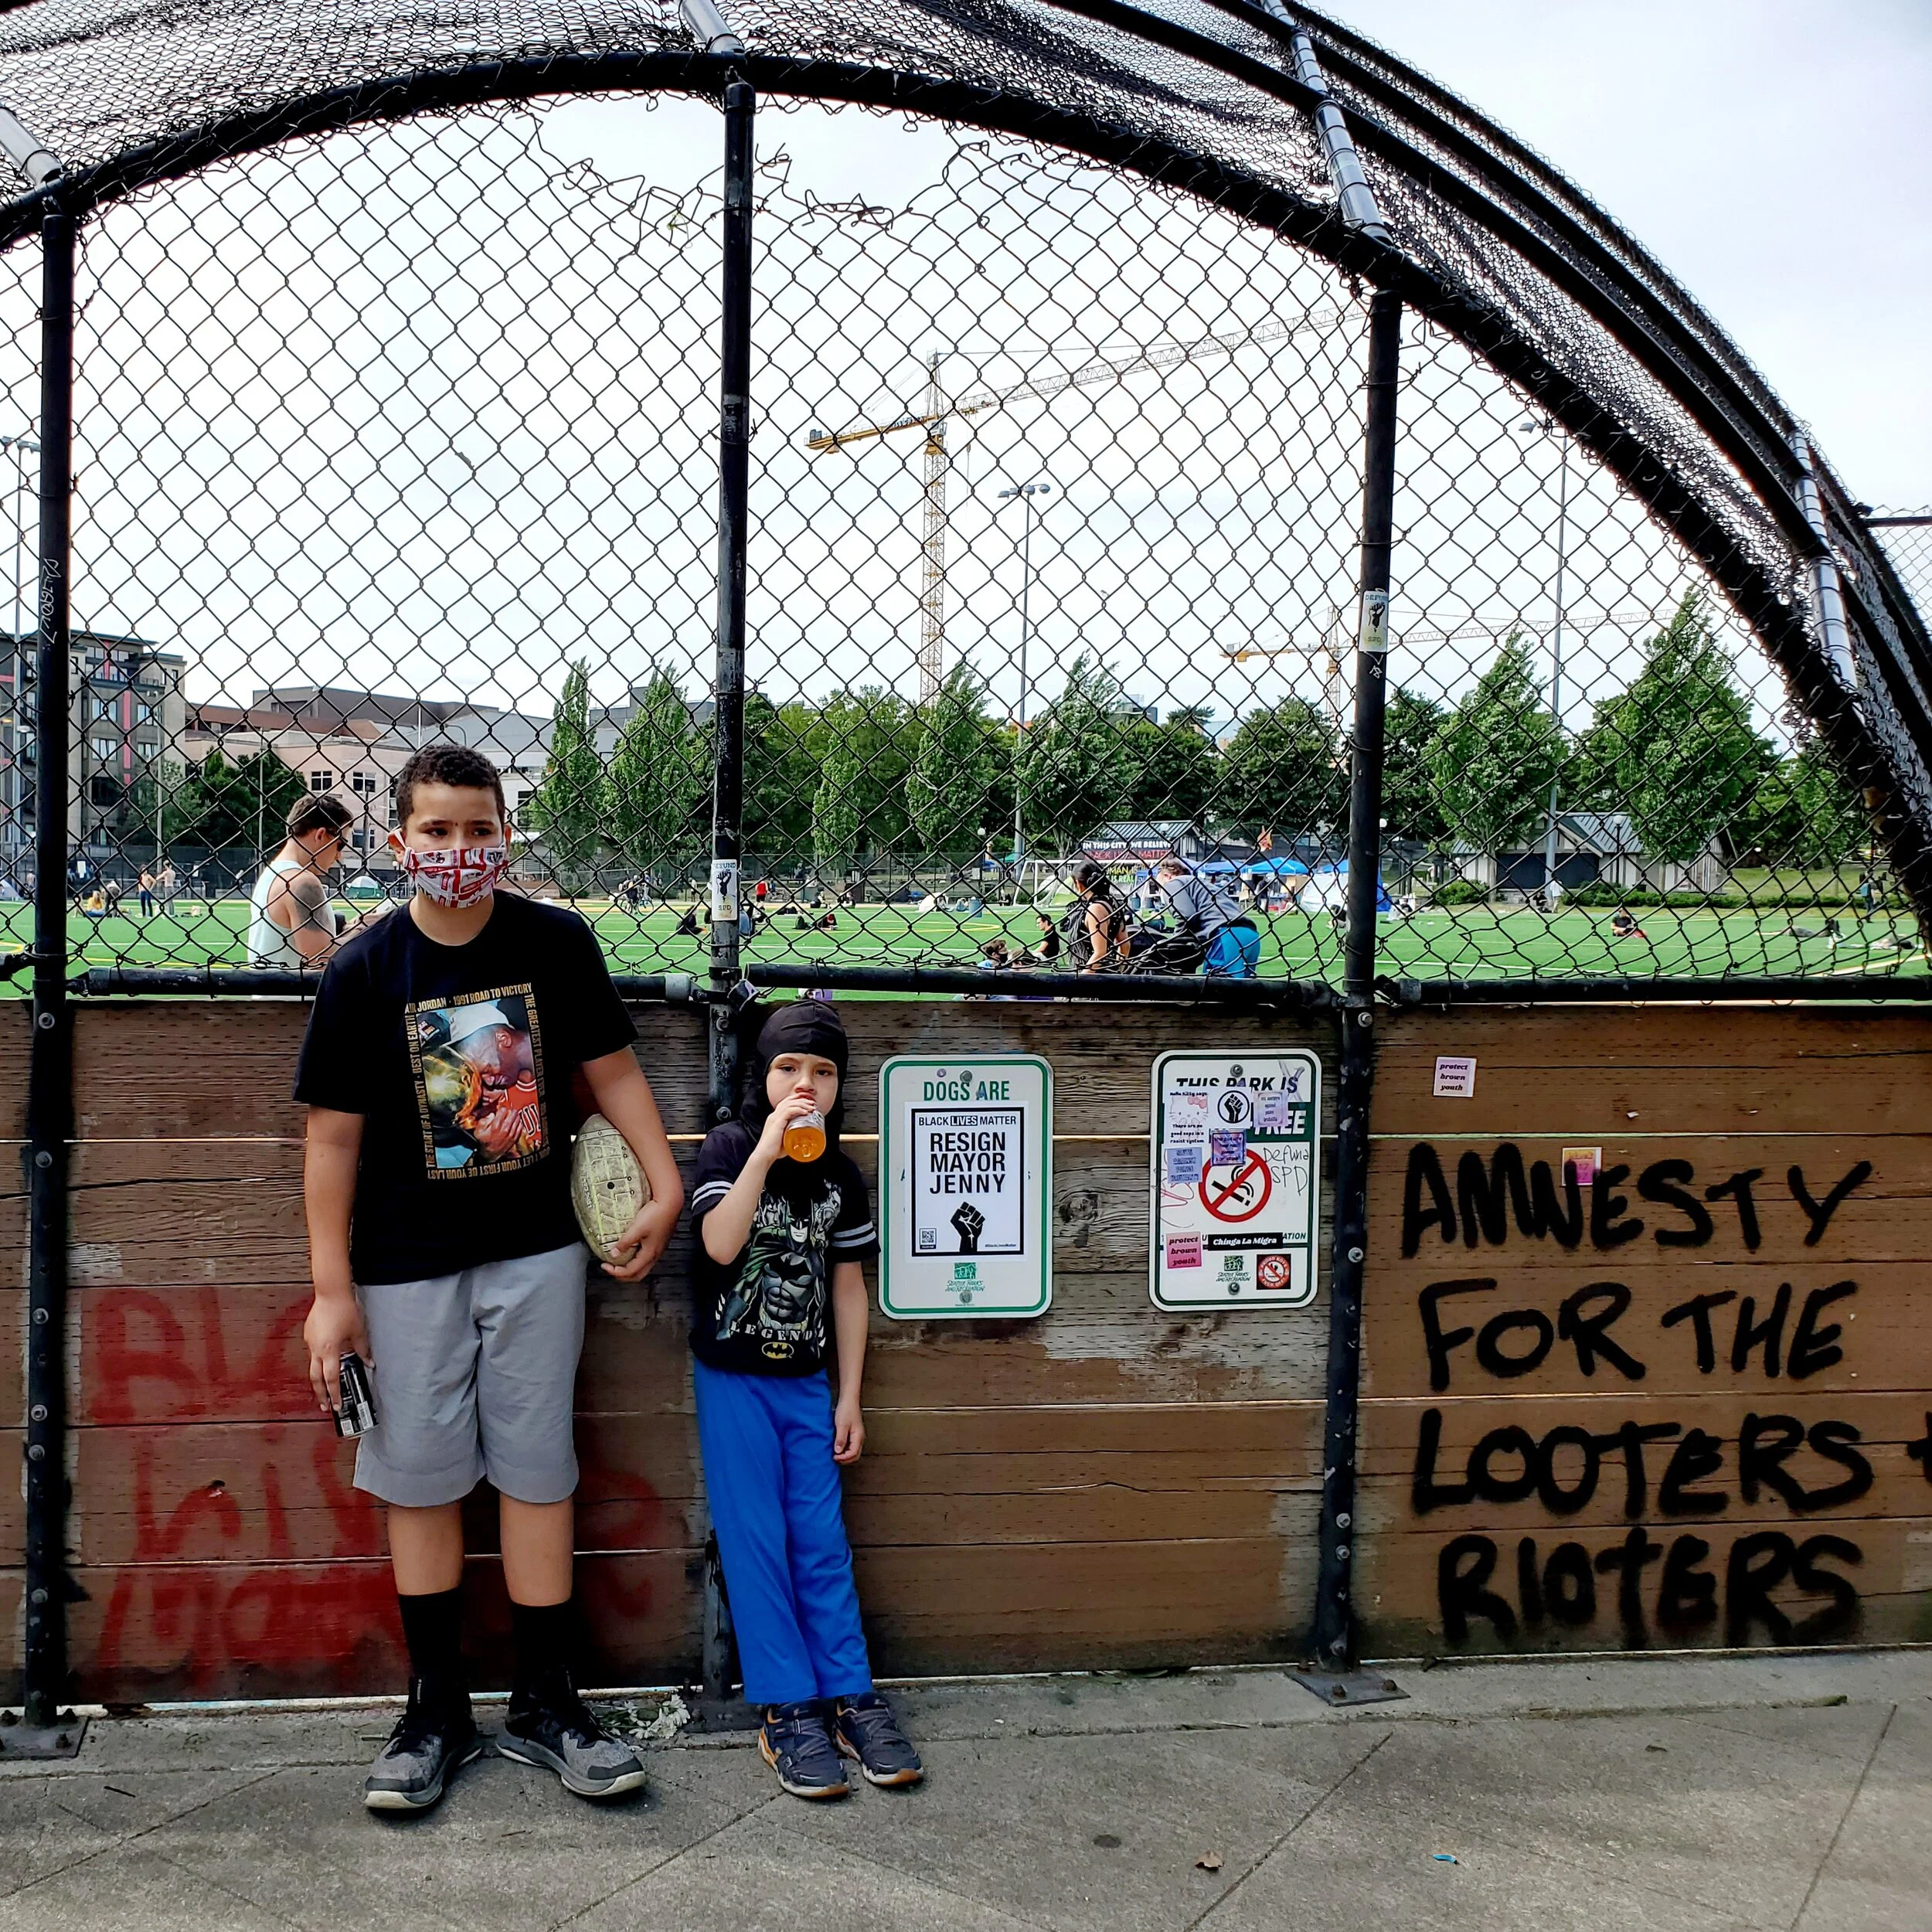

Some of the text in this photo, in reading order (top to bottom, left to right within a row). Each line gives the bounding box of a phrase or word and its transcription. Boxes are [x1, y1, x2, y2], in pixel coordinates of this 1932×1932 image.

[417, 997, 447, 1012] JORDAN
[453, 994, 469, 1005] 1991
[470, 991, 490, 1003] ROAD
[490, 988, 502, 998] TO
[502, 982, 532, 996] VICTORY
[524, 993, 536, 1009] THE
[527, 1008, 541, 1046] GREATEST
[405, 1015, 422, 1074] BEST ON EARTH
[533, 1047, 545, 1077] PLAYER
[923, 1080, 1010, 1100] DOGS ARE
[1226, 1077, 1275, 1091] PARK
[1280, 1077, 1298, 1093] IS
[414, 1080, 429, 1113] DYNASTY
[420, 1119, 431, 1129] OF
[919, 1116, 1016, 1126] BLACK LIVES MATTER
[422, 1130, 434, 1153] START
[930, 1131, 1005, 1151] RESIGN
[479, 1162, 501, 1176] FIRST
[501, 1159, 522, 1172] YOUR
[522, 1155, 533, 1167] LET
[930, 1152, 1005, 1172] MAYOR
[427, 1168, 445, 1179] LAST
[446, 1168, 467, 1179] YOUR
[468, 1167, 478, 1177] BE
[1270, 1165, 1308, 1196] SPD
[930, 1173, 1005, 1194] JENNY
[1401, 1141, 1872, 1259] AMNESTY
[1168, 1236, 1199, 1245] protect
[1213, 1236, 1241, 1247] Chinga
[1252, 1236, 1277, 1246] Migra
[730, 1320, 813, 1341] LEGEND
[1417, 1277, 1859, 1391] FOR THE
[1411, 1407, 1875, 1520] LOOTERS
[1437, 1526, 1864, 1650] RIOTERS
